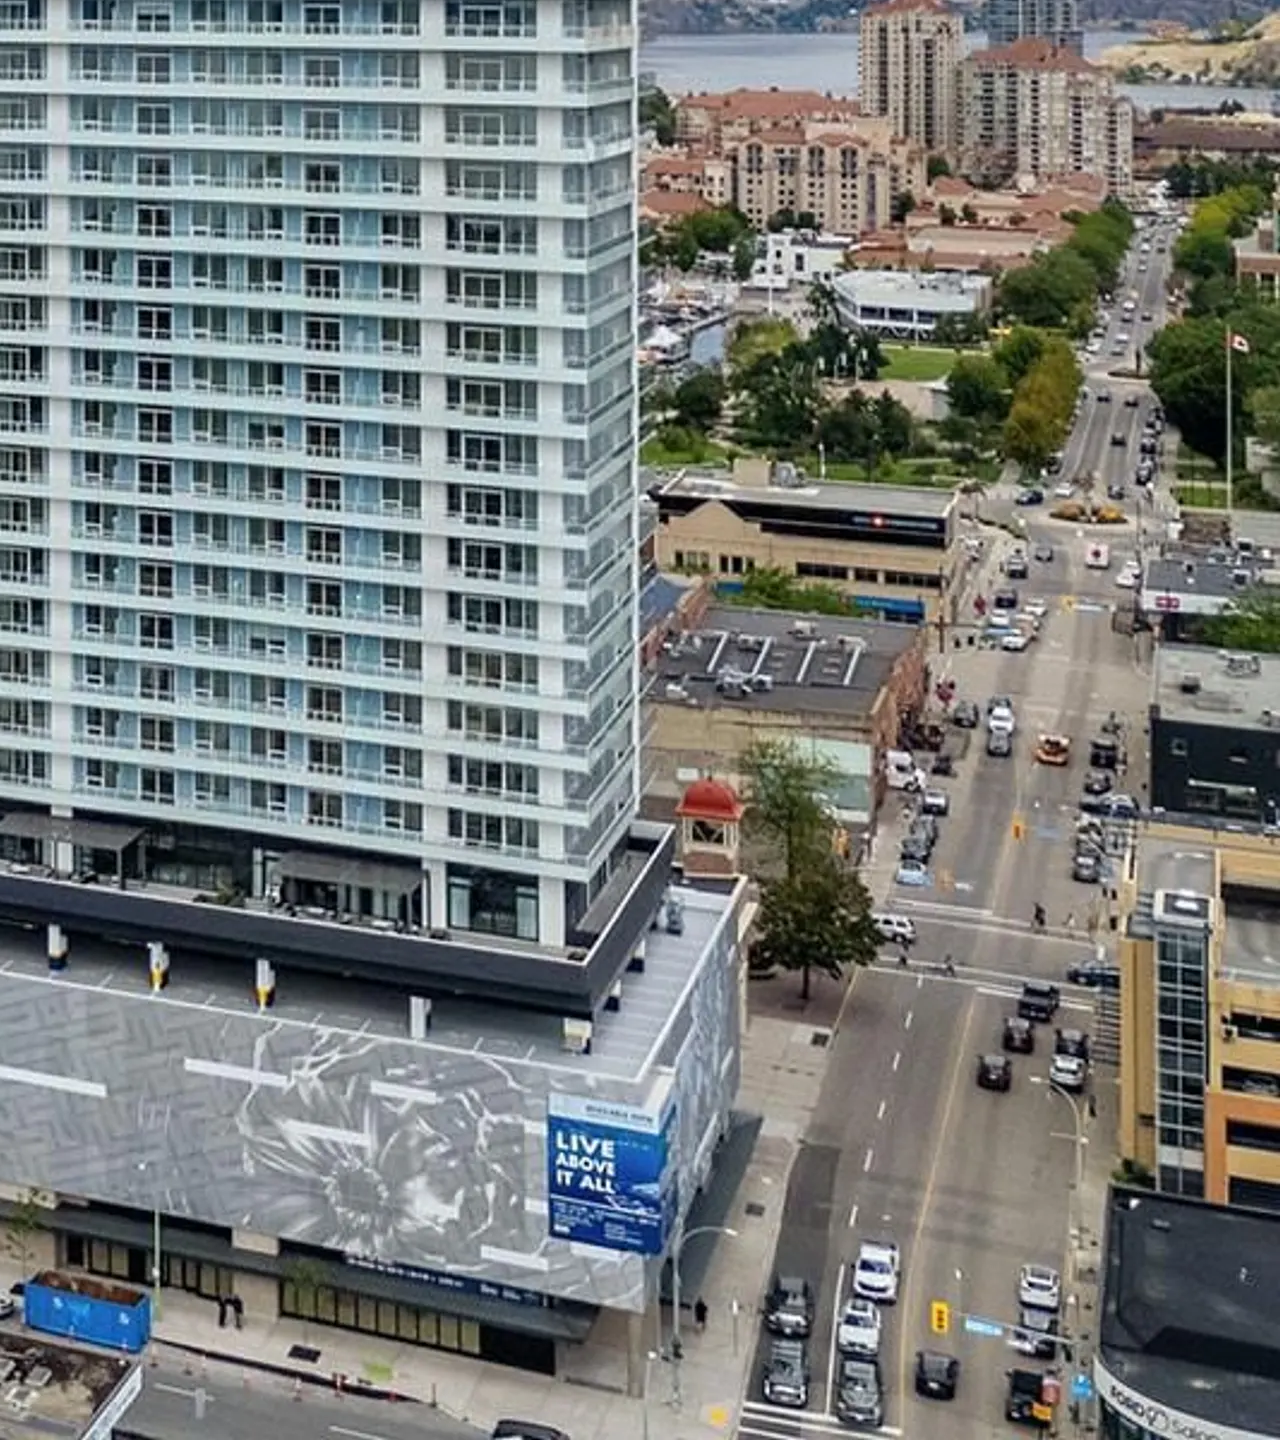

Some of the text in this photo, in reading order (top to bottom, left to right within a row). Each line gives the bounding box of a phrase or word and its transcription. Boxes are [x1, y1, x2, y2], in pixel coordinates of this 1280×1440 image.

[556, 1130, 615, 1159] LIVE
[556, 1152, 616, 1177] ABOVE
[557, 1169, 616, 1195] IT ALL
